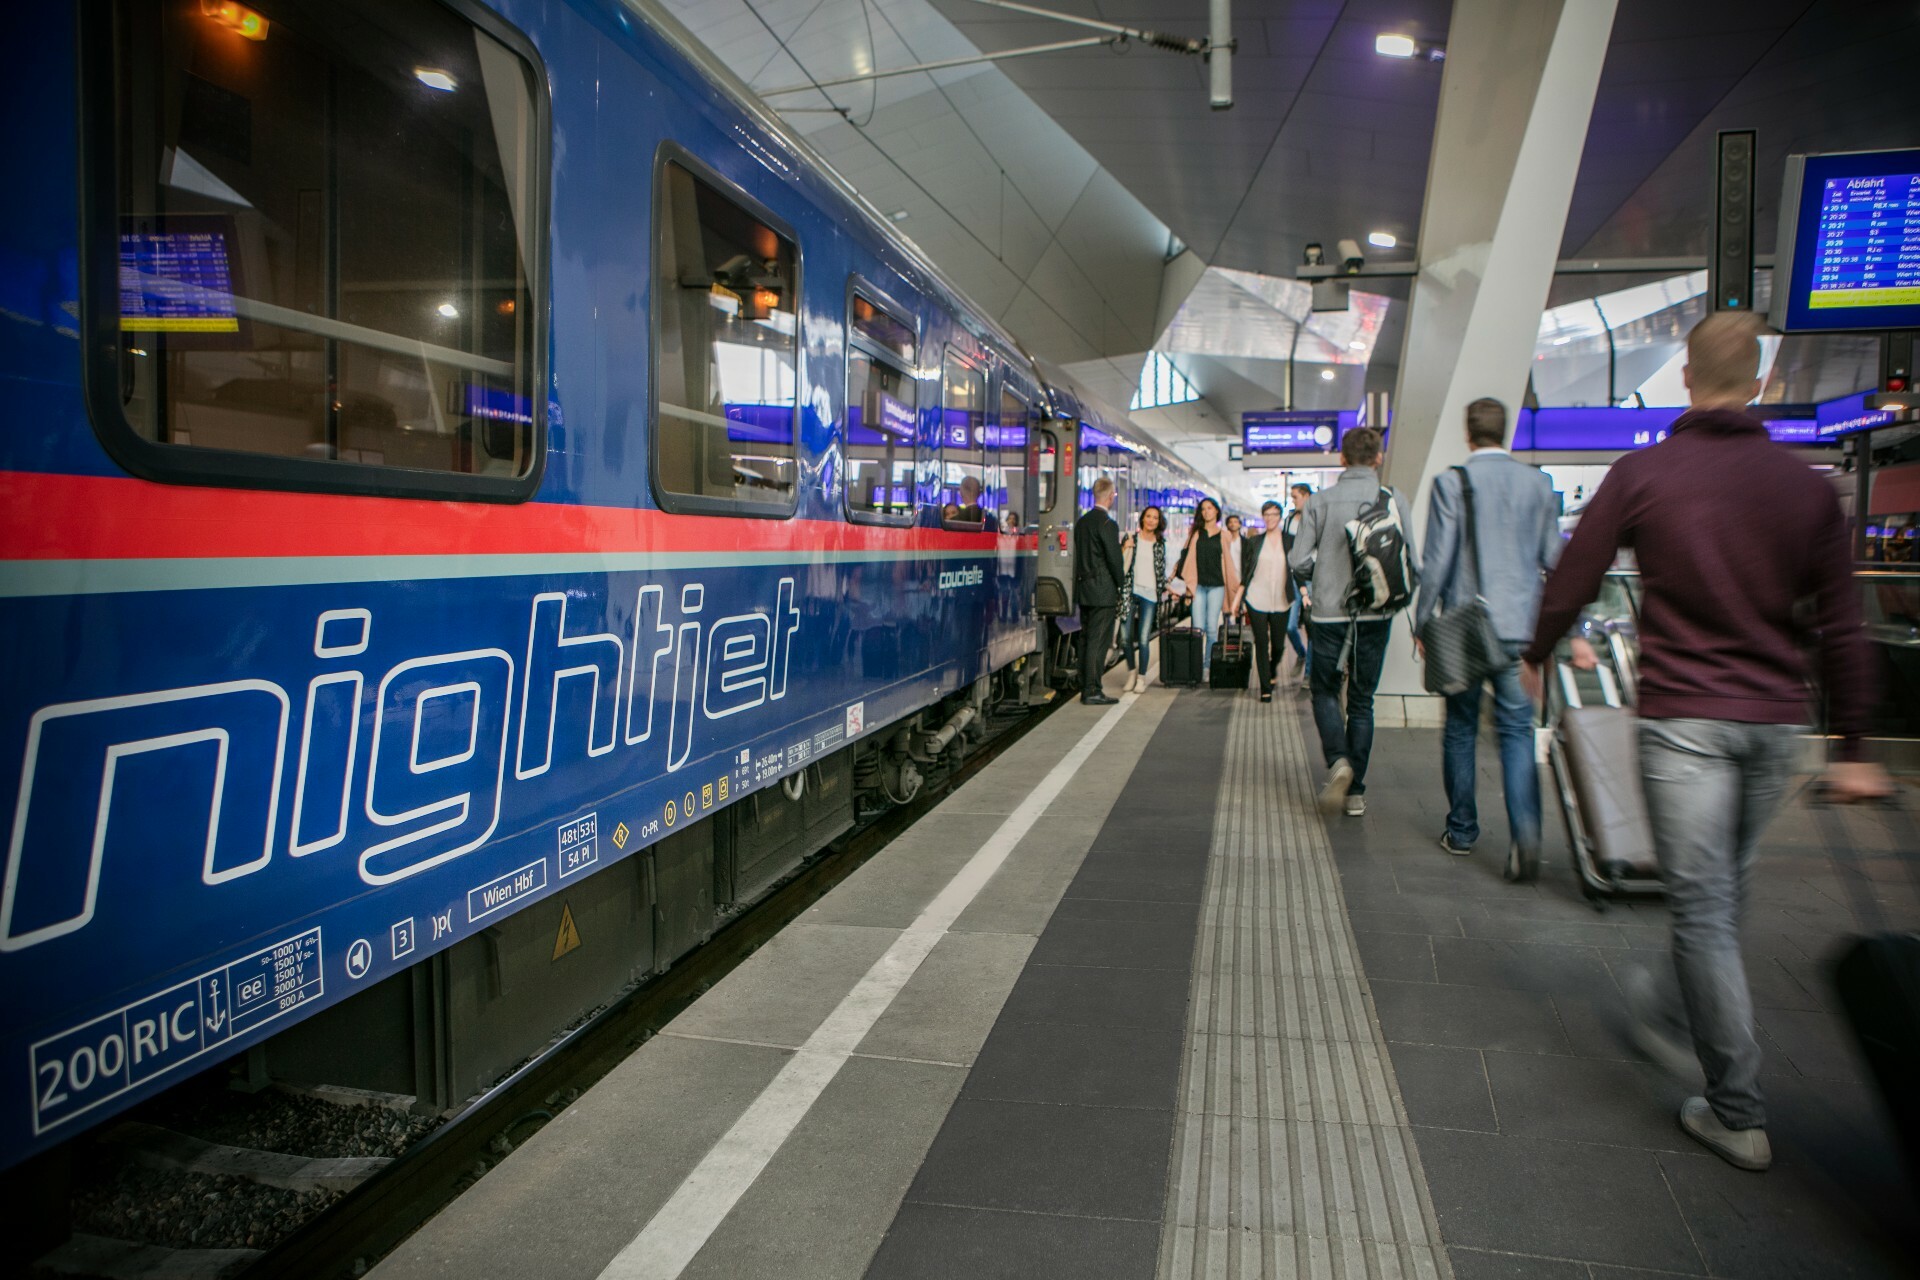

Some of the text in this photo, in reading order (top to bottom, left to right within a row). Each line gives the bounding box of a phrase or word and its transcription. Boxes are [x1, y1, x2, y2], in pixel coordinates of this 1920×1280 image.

[1846, 178, 1885, 189] Abfahrt
[939, 564, 983, 589] couchette
[0, 577, 800, 953] nightjet
[561, 821, 596, 846] 48t 53t
[618, 829, 624, 843] R
[642, 820, 659, 838] O-PR
[568, 853, 579, 868] 54
[483, 870, 534, 908] Wien Hbf
[399, 930, 408, 947] 3
[273, 943, 294, 960] 1000
[296, 939, 302, 950] V
[273, 955, 294, 972] 1500
[296, 951, 302, 962] V
[274, 962, 303, 984] 1500 V
[242, 980, 262, 1000] ee
[274, 974, 303, 996] 3000 V
[280, 990, 305, 1009] 800 A
[39, 1001, 196, 1112] 200 RIC
